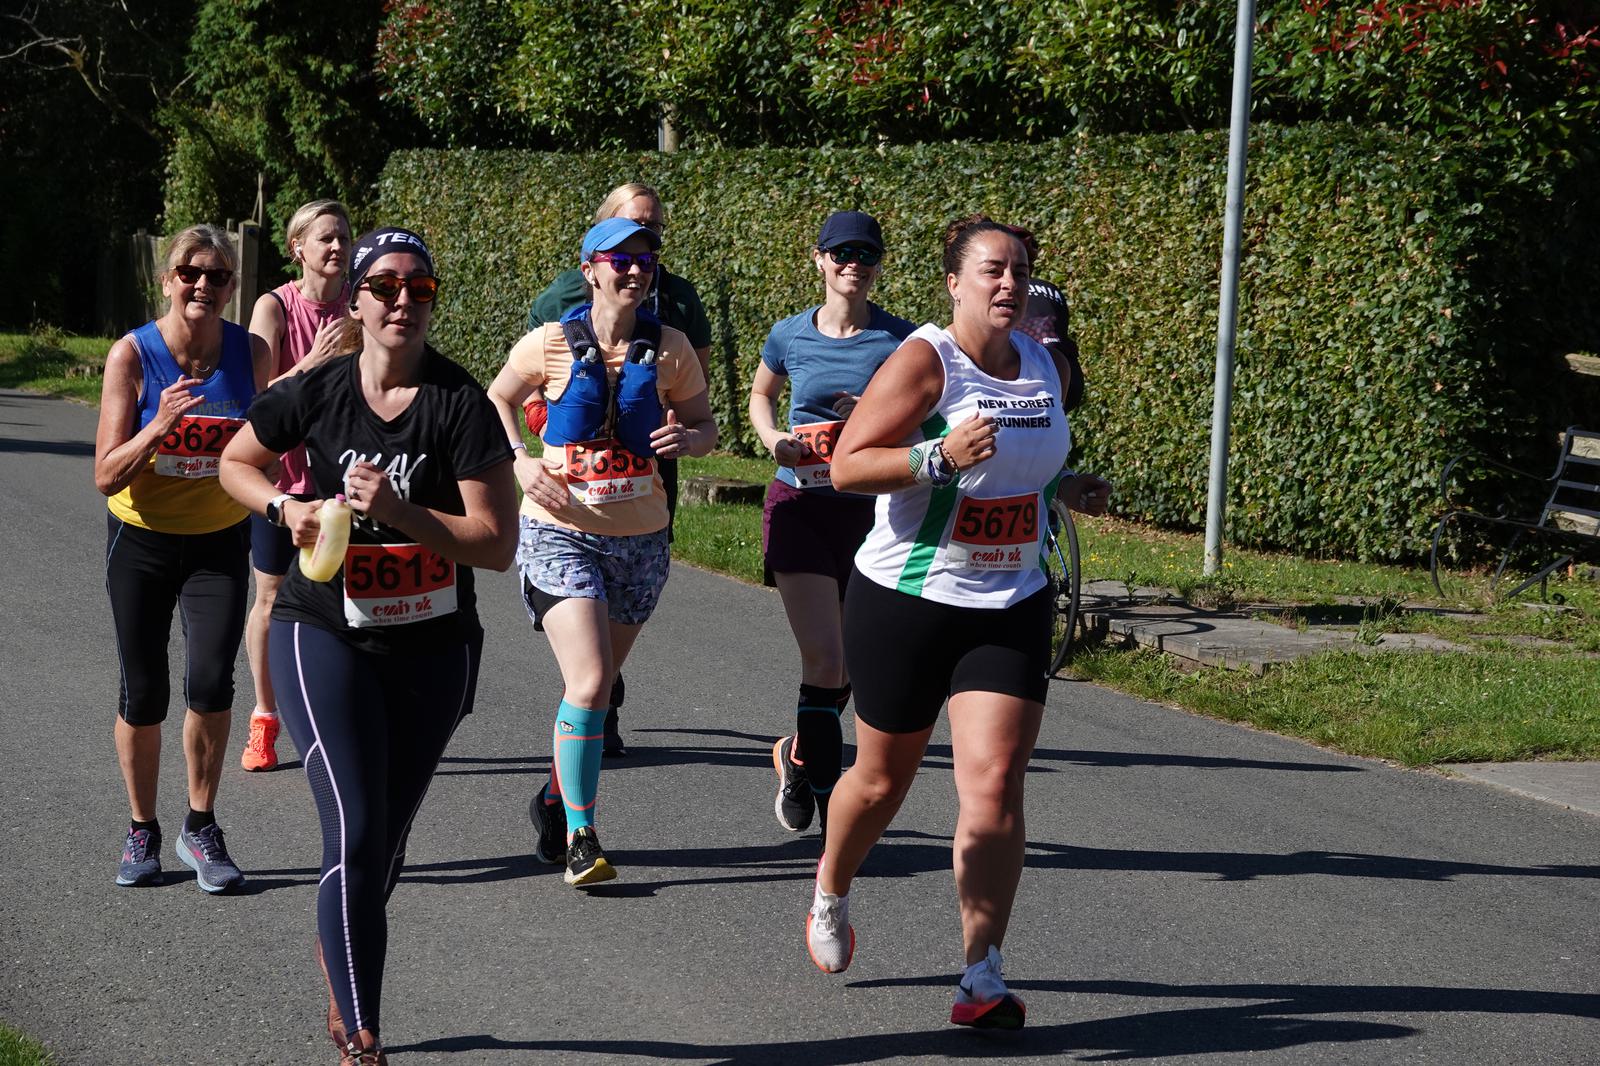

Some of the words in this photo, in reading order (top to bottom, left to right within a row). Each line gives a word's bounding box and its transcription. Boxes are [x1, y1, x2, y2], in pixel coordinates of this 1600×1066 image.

[977, 399, 1008, 409] NEW
[1010, 398, 1055, 409] FOREST
[996, 416, 1051, 428] RUNNERS
[960, 502, 1036, 540] 5679
[350, 552, 450, 591] 5613
